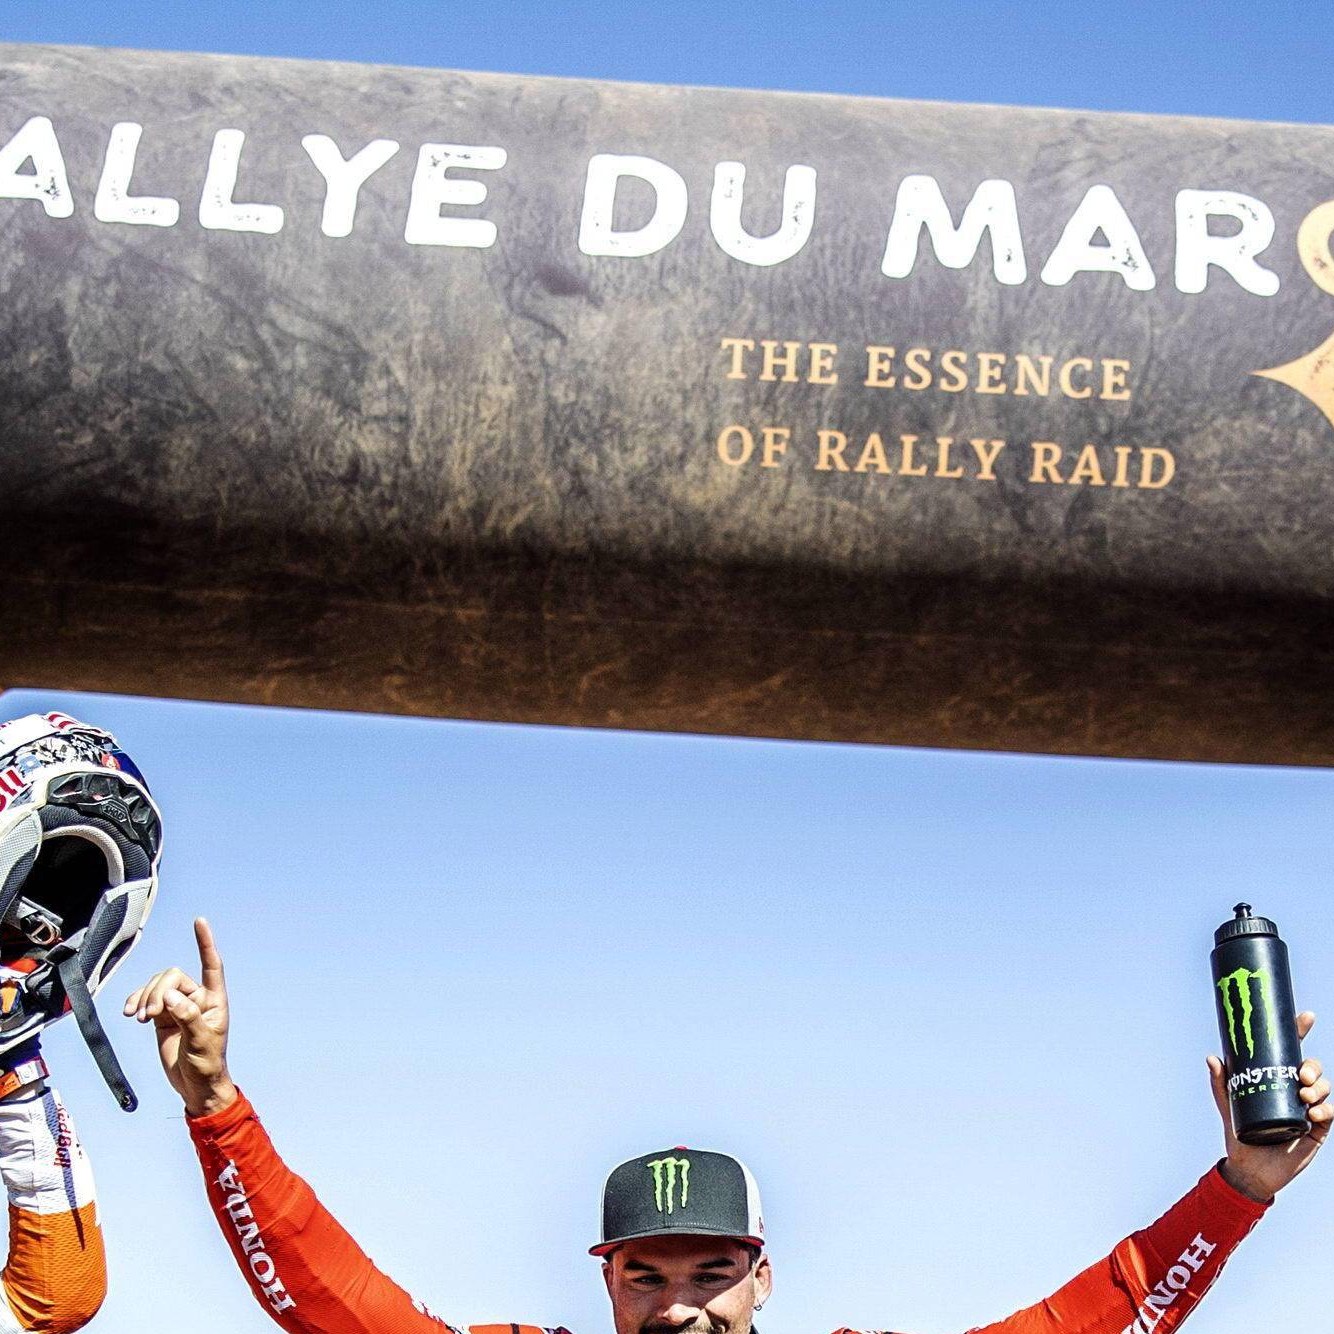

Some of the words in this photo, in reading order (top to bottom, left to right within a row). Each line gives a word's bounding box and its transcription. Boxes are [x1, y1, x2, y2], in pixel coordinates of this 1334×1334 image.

[577, 153, 817, 267] DU
[719, 338, 839, 386] THE
[863, 345, 1133, 401] ESSENCE
[716, 424, 792, 469] OF
[817, 431, 1001, 482] RALLY
[1028, 441, 1178, 490] RAID
[1228, 1065, 1300, 1094] ONSTER
[213, 1159, 297, 1315] HONDA
